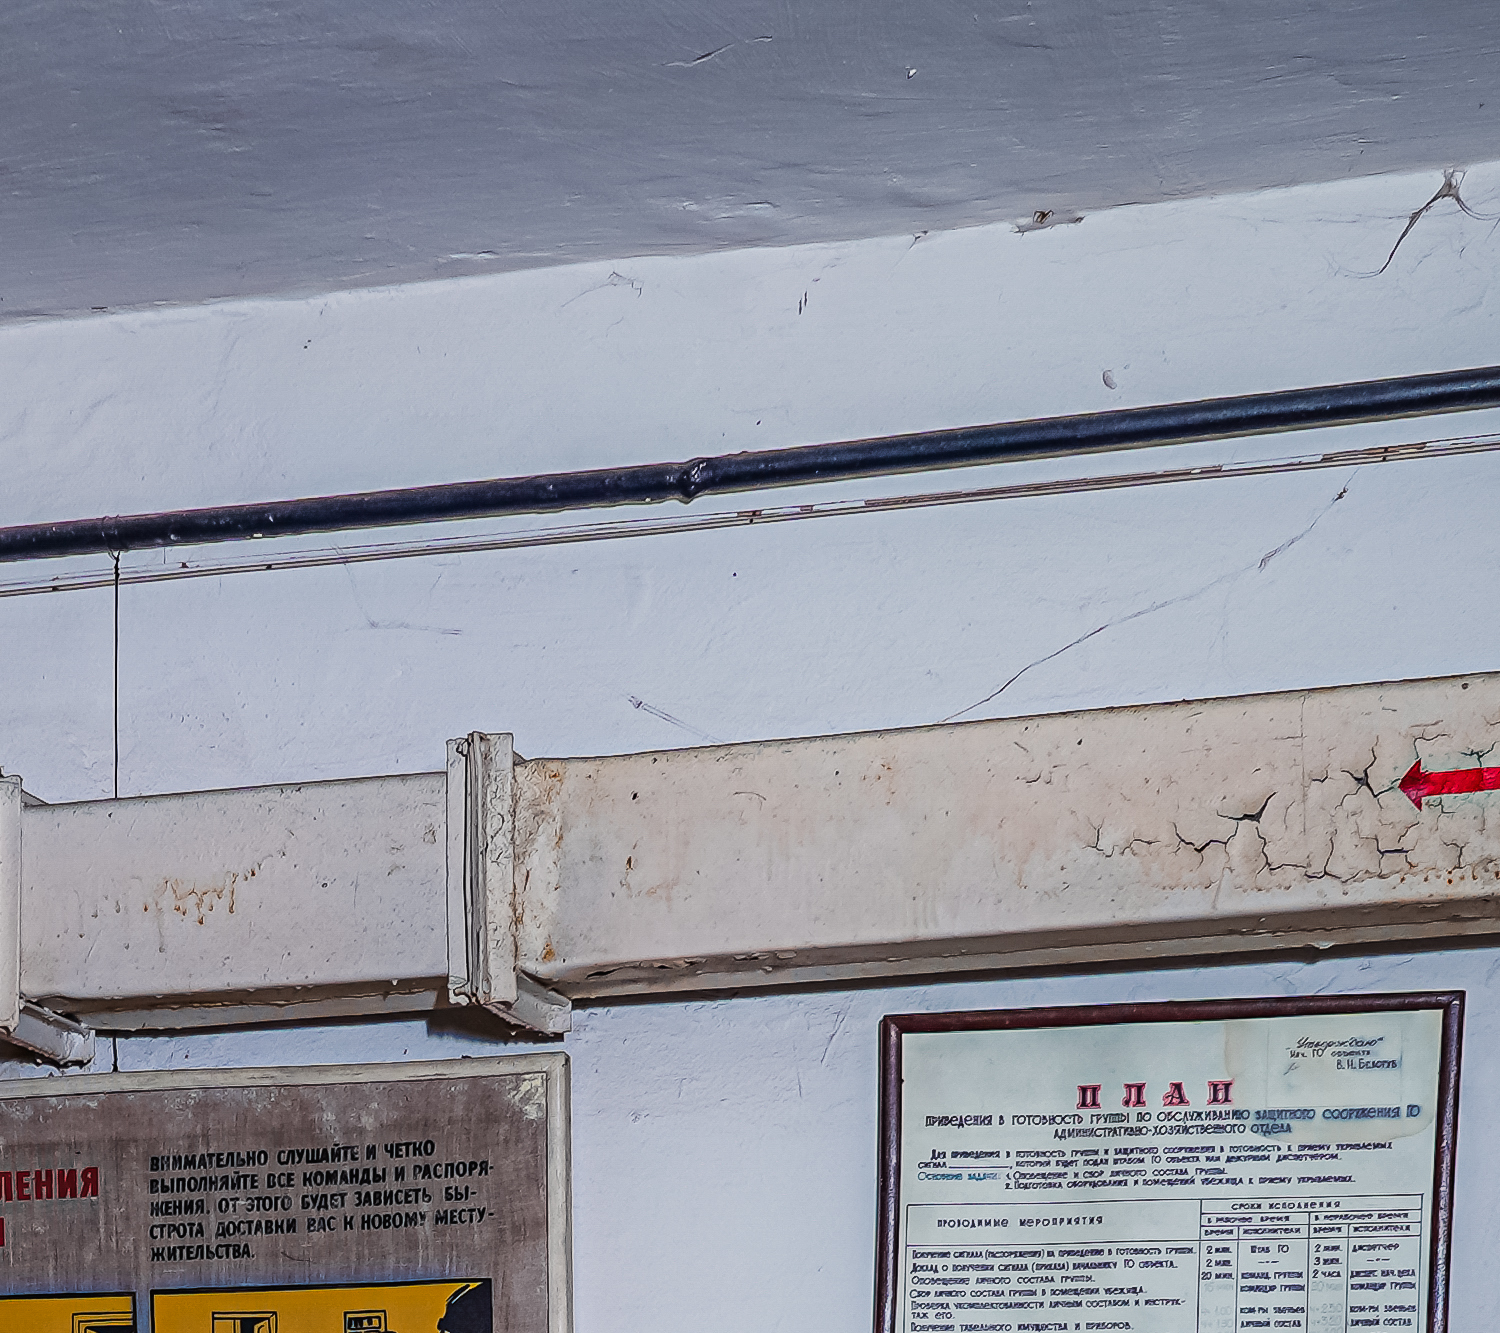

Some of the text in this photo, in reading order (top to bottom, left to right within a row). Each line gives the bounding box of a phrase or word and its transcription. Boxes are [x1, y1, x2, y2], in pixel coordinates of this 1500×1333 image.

[1076, 1078, 1234, 1109] ПЛАН
[999, 1116, 1004, 1125] В
[1012, 1114, 1083, 1125] ГОТОВНОСТЬ
[149, 1140, 435, 1171] ВНИМАТЕЛЬНО СЛУШАЙТЕ И ЧЕТКО
[149, 1160, 494, 1194] ВЫПОЛНЯЙТЕ ВСЕ КОМАНДЫ И РАСПОРЯ-
[150, 1185, 477, 1217] ЖЕНИЯ. ОТ ЭТОГО БУДЕТ ЗАВИСЕТЬ БЫ-
[150, 1222, 204, 1239] СТРОТА
[215, 1218, 296, 1238] ДОСТАВКИ
[307, 1216, 335, 1233] ВАС
[344, 1216, 353, 1230] К
[361, 1211, 426, 1230] НОВОМУ
[151, 1243, 255, 1262] ЖИТЕЛЬСТВА.
